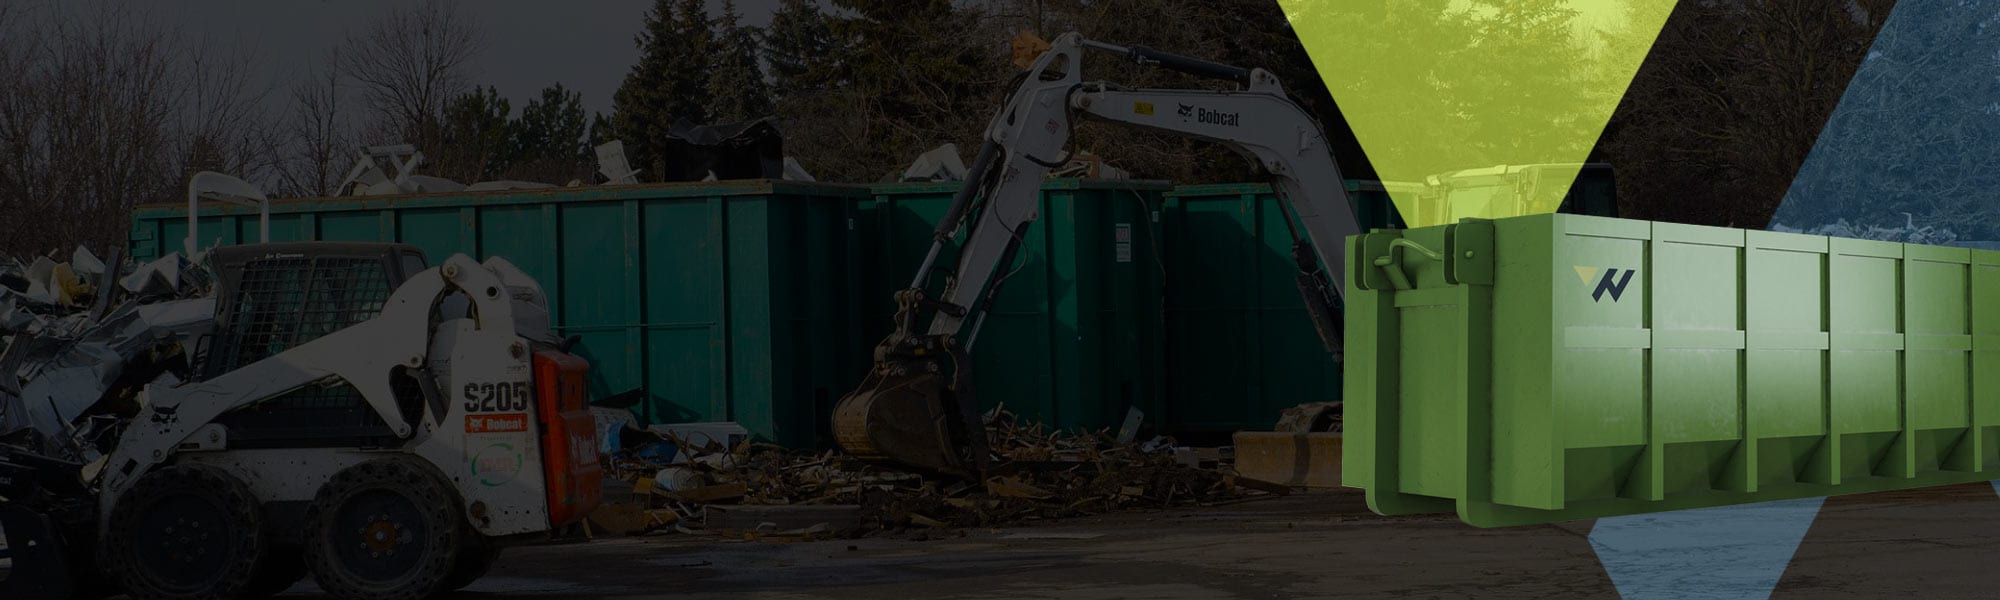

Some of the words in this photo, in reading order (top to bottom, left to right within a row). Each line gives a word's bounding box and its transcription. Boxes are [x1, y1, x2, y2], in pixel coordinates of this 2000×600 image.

[1198, 107, 1240, 127] Bobcat
[464, 381, 528, 412] S205
[486, 417, 523, 431] Bobcat
